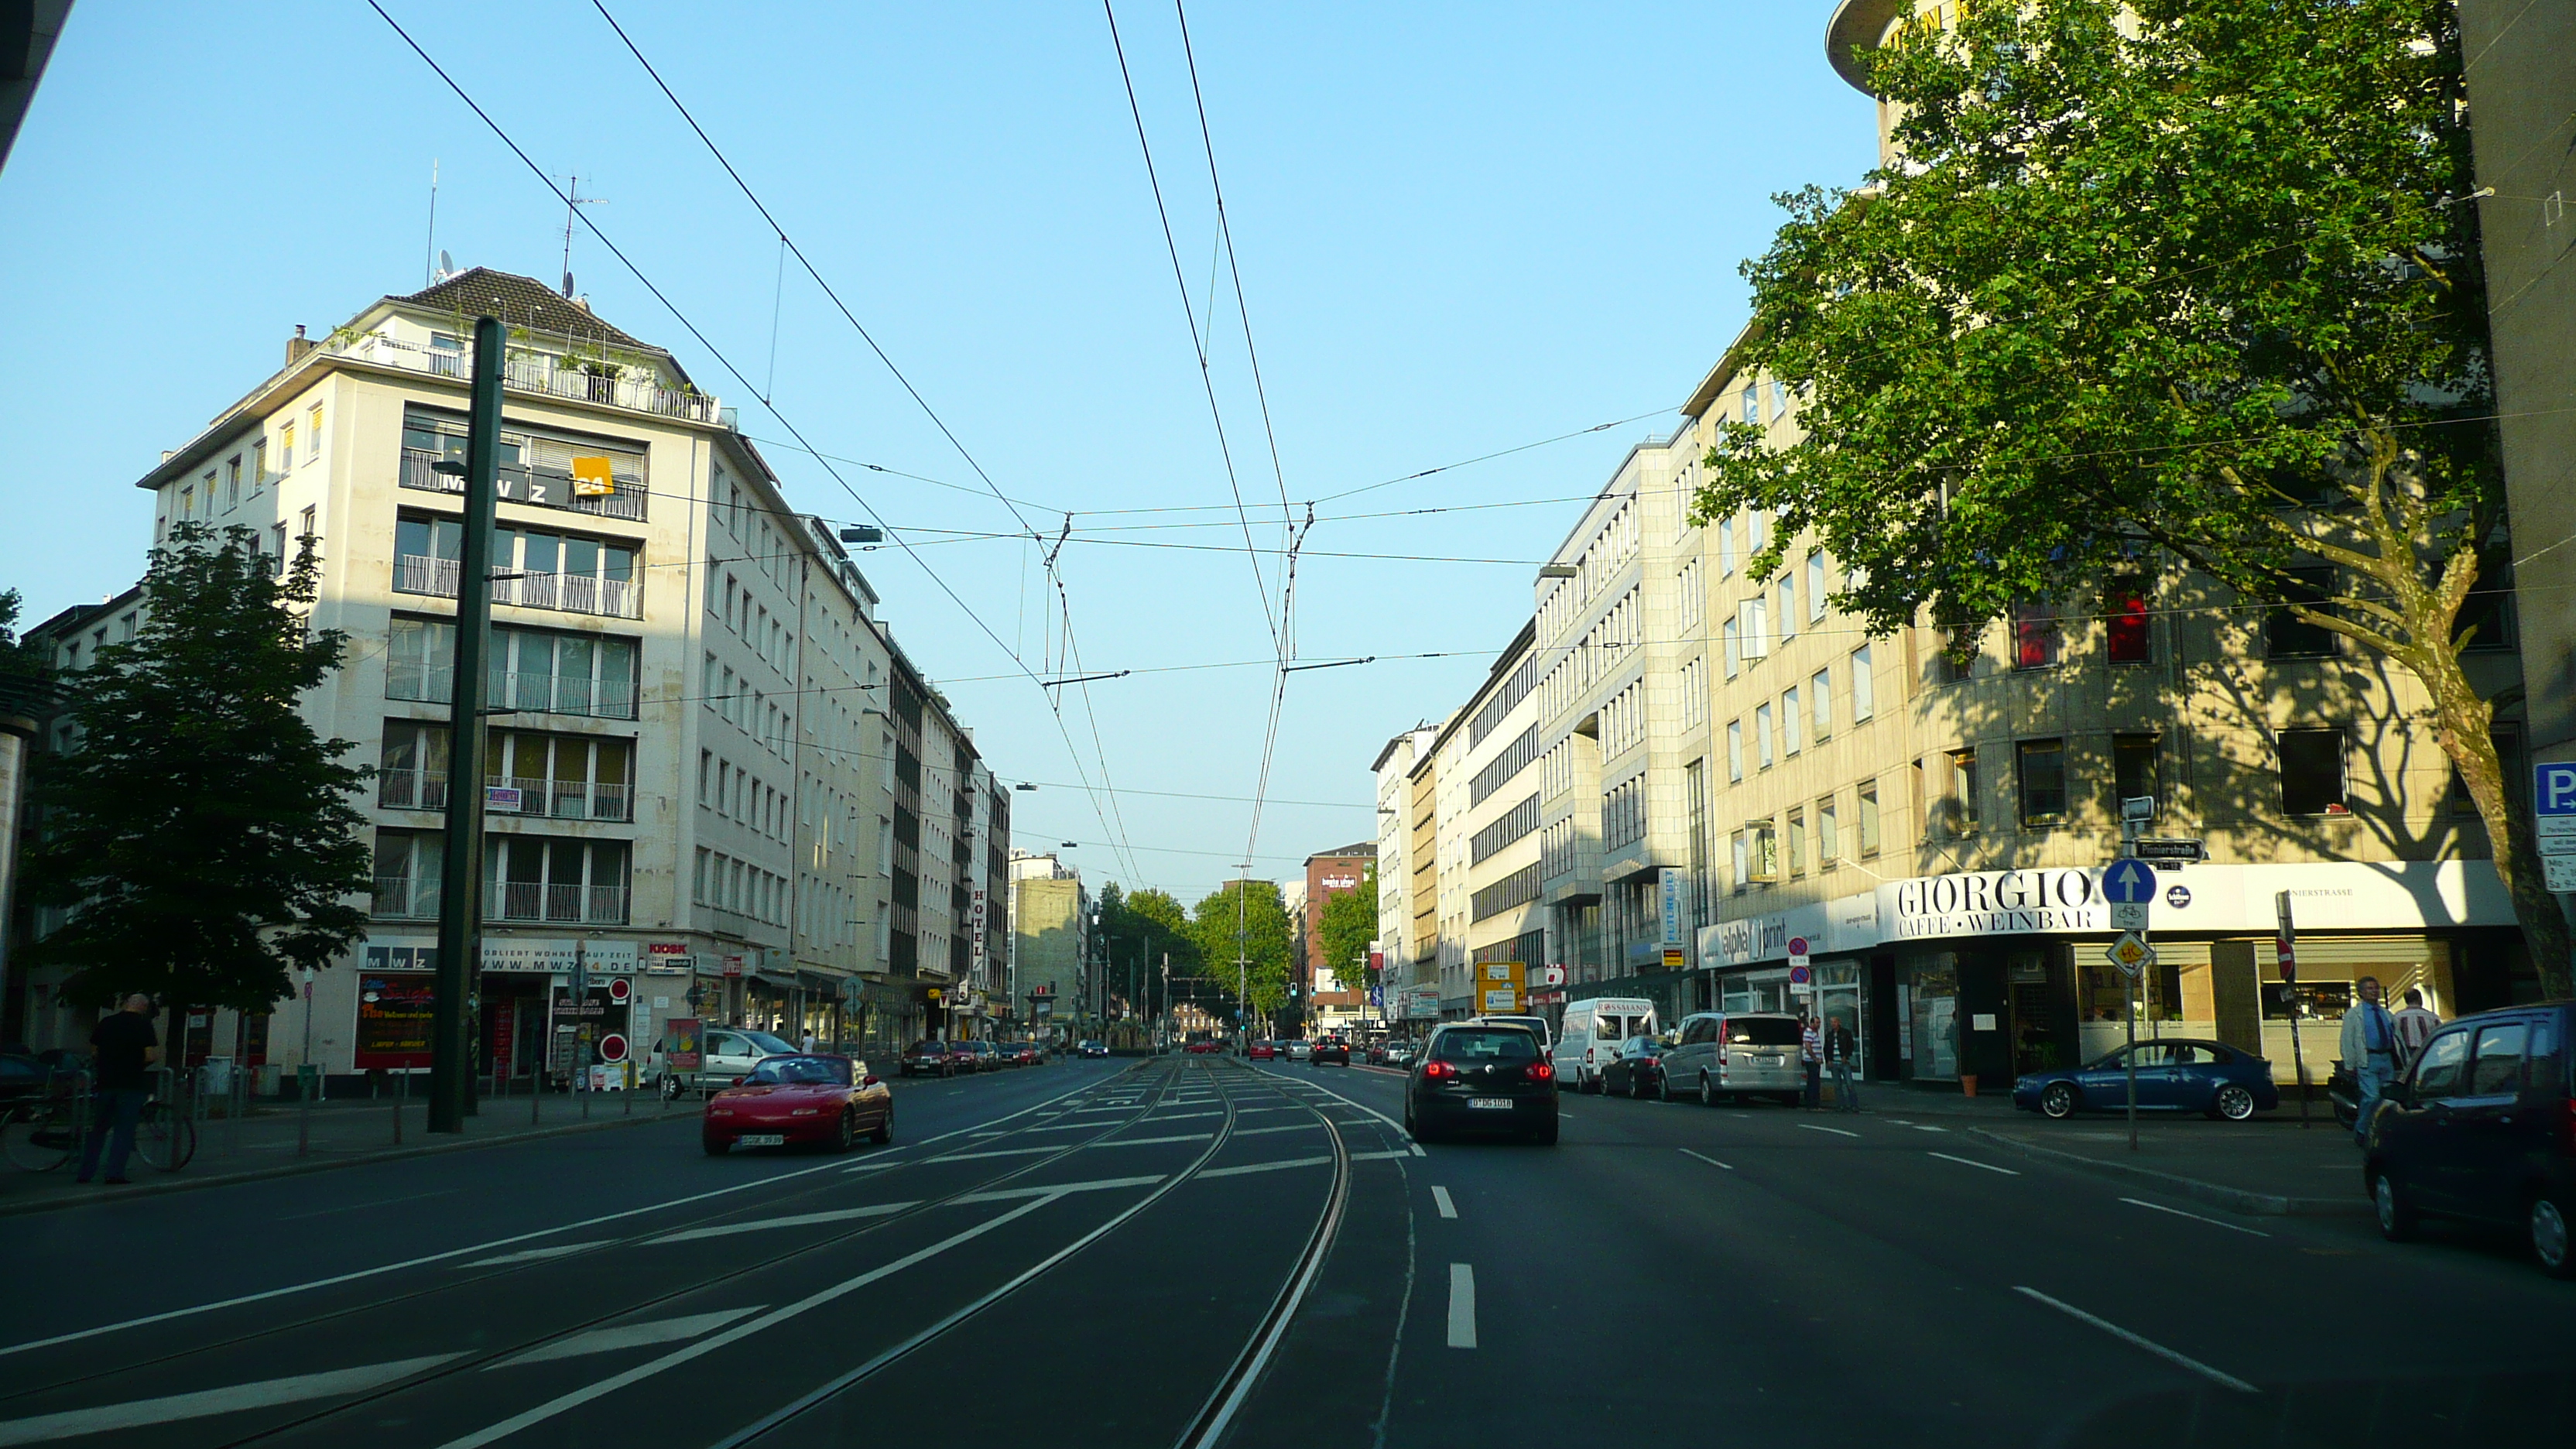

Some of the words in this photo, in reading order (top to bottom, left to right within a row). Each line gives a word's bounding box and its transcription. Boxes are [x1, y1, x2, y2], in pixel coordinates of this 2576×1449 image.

[2547, 769, 2576, 809] P
[2141, 843, 2195, 855] Pionierstraße
[1665, 870, 1674, 892] BET
[1899, 869, 2091, 918] GIORGIO
[975, 890, 984, 956] HOTEL
[1667, 896, 1675, 941] FUTURE
[1899, 916, 1951, 937] CAFFE
[1968, 910, 2091, 931] WEINBAR
[649, 944, 687, 954] KIOSK
[1723, 924, 1749, 961] alpha
[1762, 917, 1787, 957] print
[588, 976, 606, 985] lboro
[1598, 1004, 1650, 1012] ROSSMANN
